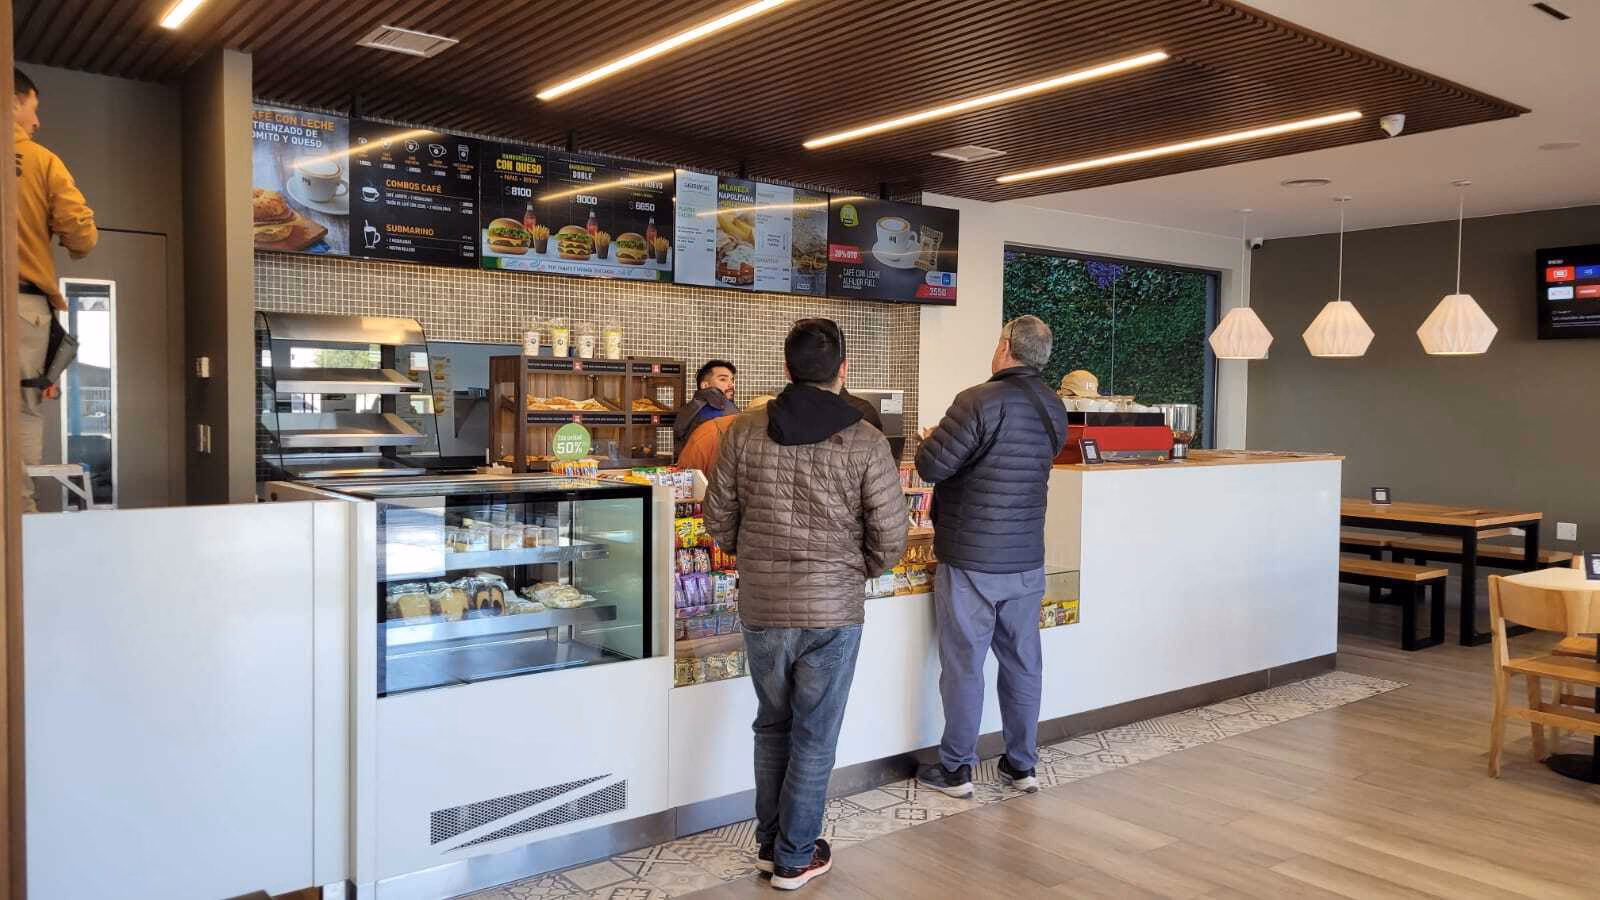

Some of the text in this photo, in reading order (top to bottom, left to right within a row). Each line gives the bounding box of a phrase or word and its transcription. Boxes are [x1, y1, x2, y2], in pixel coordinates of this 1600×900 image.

[275, 113, 298, 126] CON
[301, 117, 336, 132] LECHE
[254, 122, 319, 138] TRENZADO DE
[251, 131, 322, 148] OMITO Y QUESO
[496, 159, 542, 174] CON QUESO
[385, 179, 442, 193] COMBOS CAFÉ
[718, 191, 754, 203] NAPOLITANA
[385, 224, 435, 236] SUBMARINO
[556, 441, 583, 454] 50%
